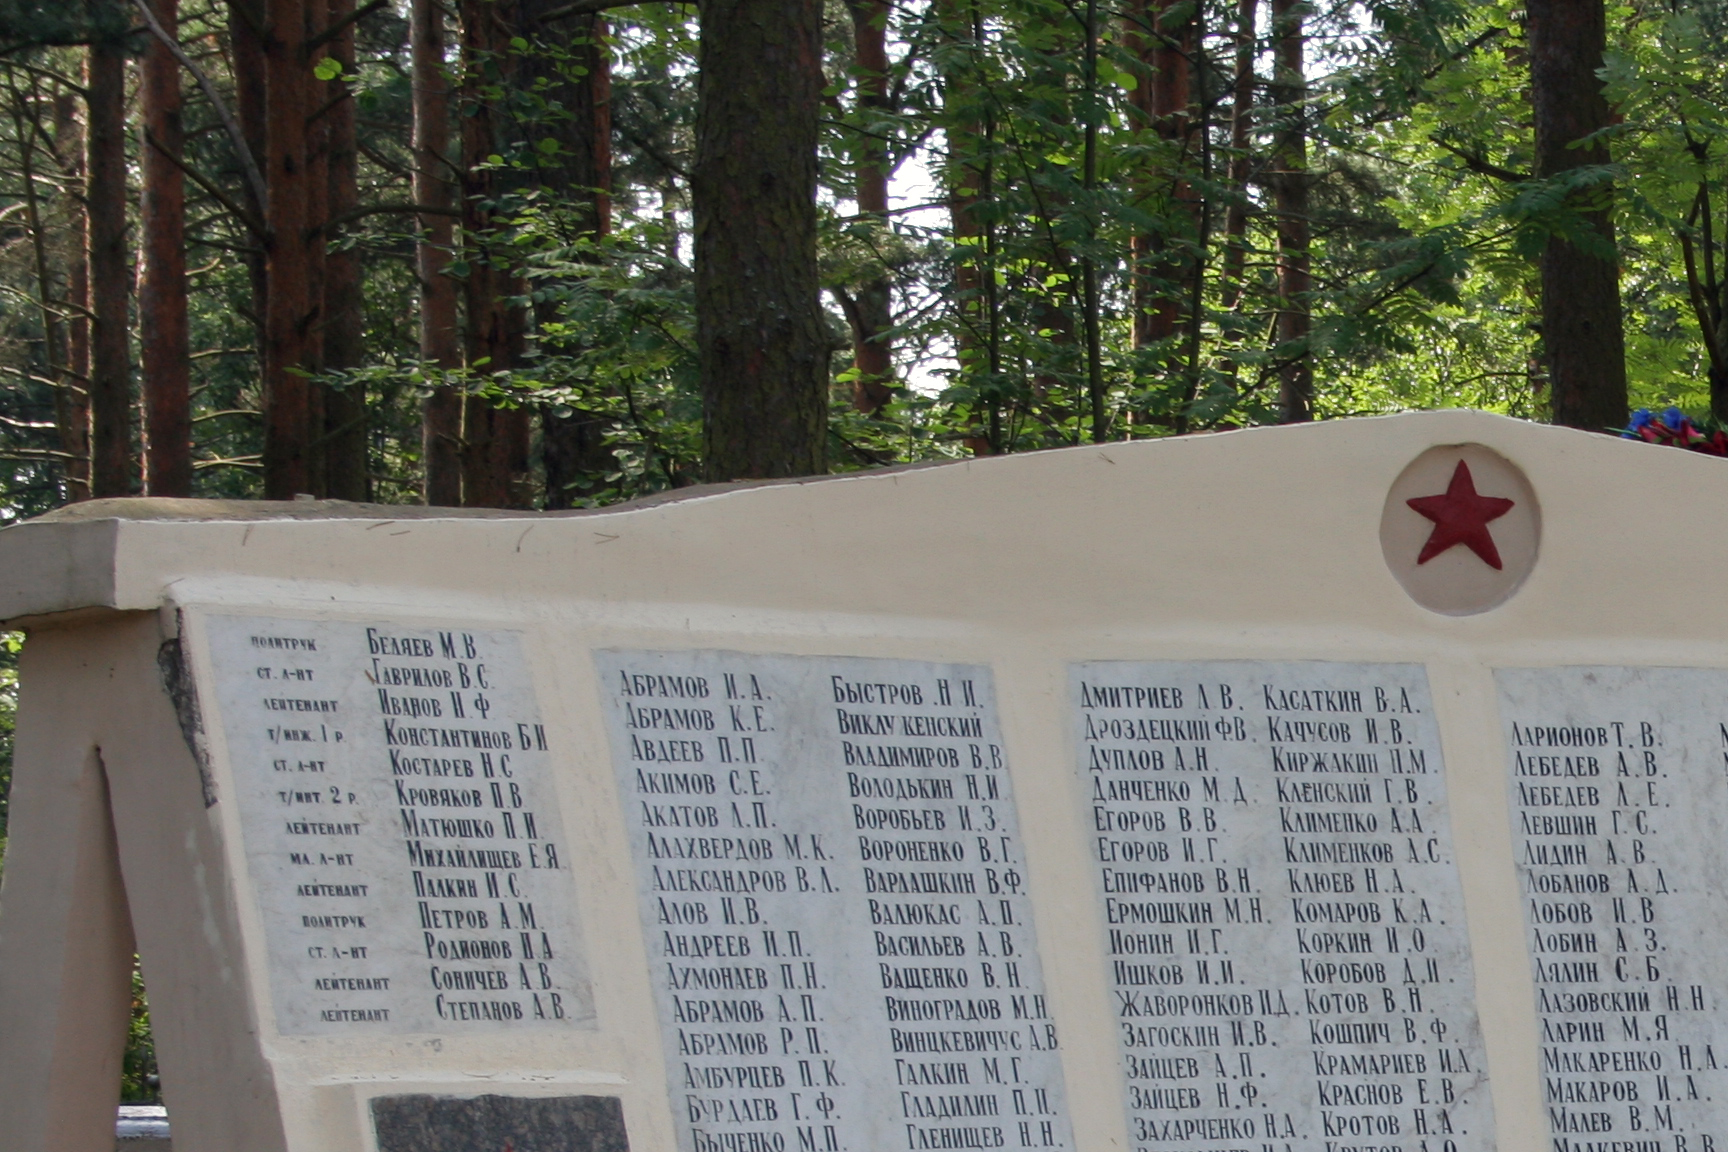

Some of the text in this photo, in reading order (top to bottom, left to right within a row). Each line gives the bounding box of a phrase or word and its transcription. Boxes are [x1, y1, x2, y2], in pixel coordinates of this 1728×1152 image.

[620, 670, 709, 698] АБРАМОВ
[1081, 681, 1183, 710] ДМИТРИЕВ
[1515, 751, 1600, 779] ЛЕБЕДЕВ
[1093, 806, 1166, 832] ЕГОРОВ
[858, 836, 964, 861] ВОРОНЕНКО
[418, 901, 489, 929] ПЕТРОВ
[1292, 898, 1381, 923] КОМАРОВ
[1531, 899, 1593, 923] ЛОБОВ
[664, 931, 750, 959] АНДРЕЕВ
[1545, 1077, 1639, 1103] МАКАРОВ
[1321, 1111, 1400, 1137] КРОТОВ
